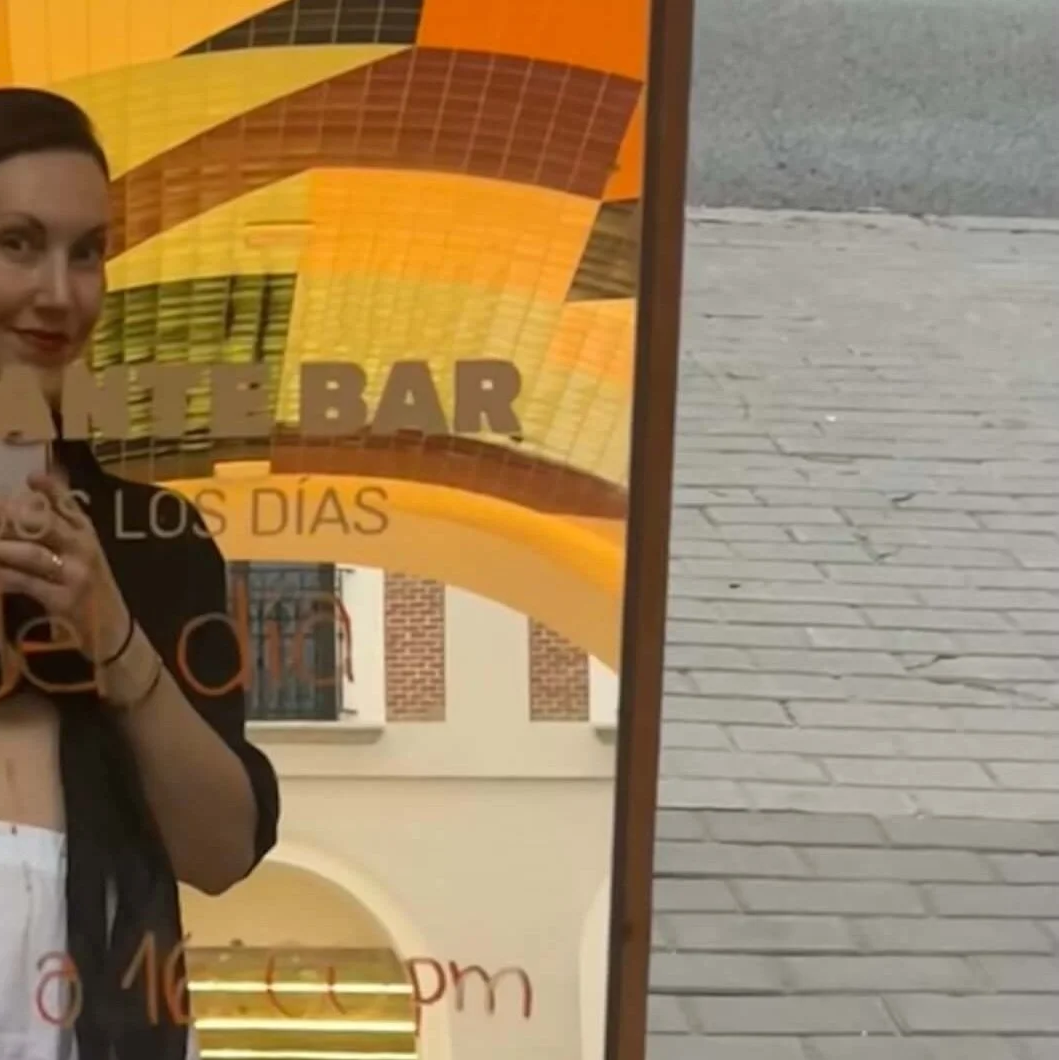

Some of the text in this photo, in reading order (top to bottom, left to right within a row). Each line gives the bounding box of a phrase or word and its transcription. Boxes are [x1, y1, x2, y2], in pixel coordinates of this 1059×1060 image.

[299, 359, 522, 435] BAR
[113, 488, 226, 540] LOS
[250, 480, 390, 537] DÍAS
[407, 956, 533, 1036] pm
